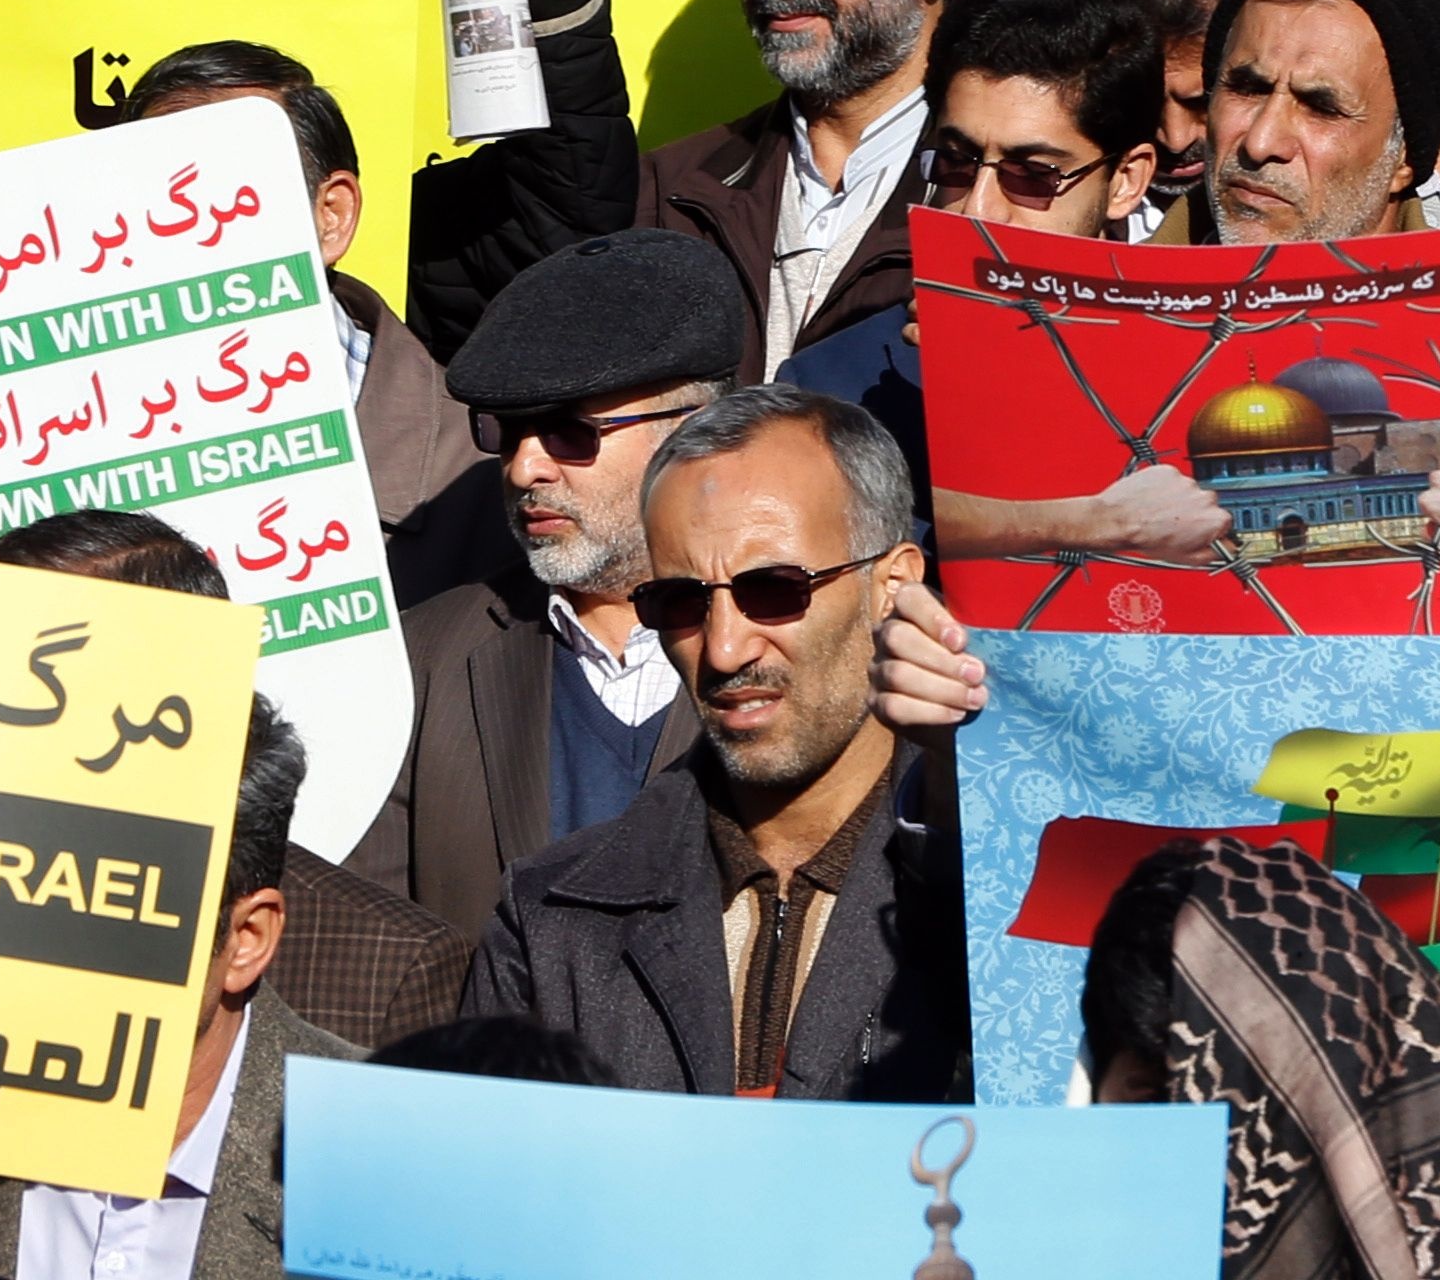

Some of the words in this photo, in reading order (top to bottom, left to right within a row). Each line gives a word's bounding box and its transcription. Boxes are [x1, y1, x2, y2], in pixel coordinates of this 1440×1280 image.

[986, 268, 1024, 292] شود
[1033, 273, 1068, 303] پاک
[1332, 276, 1405, 301] سرزمین
[1412, 273, 1435, 290] که
[44, 299, 163, 351] WITH
[179, 263, 302, 321] U.S.A
[1104, 287, 1213, 308] صهیونیست
[1222, 288, 1238, 311] از
[1244, 283, 1323, 311] فلسطین
[63, 457, 176, 512] WITH
[191, 424, 339, 488] ISRAEL
